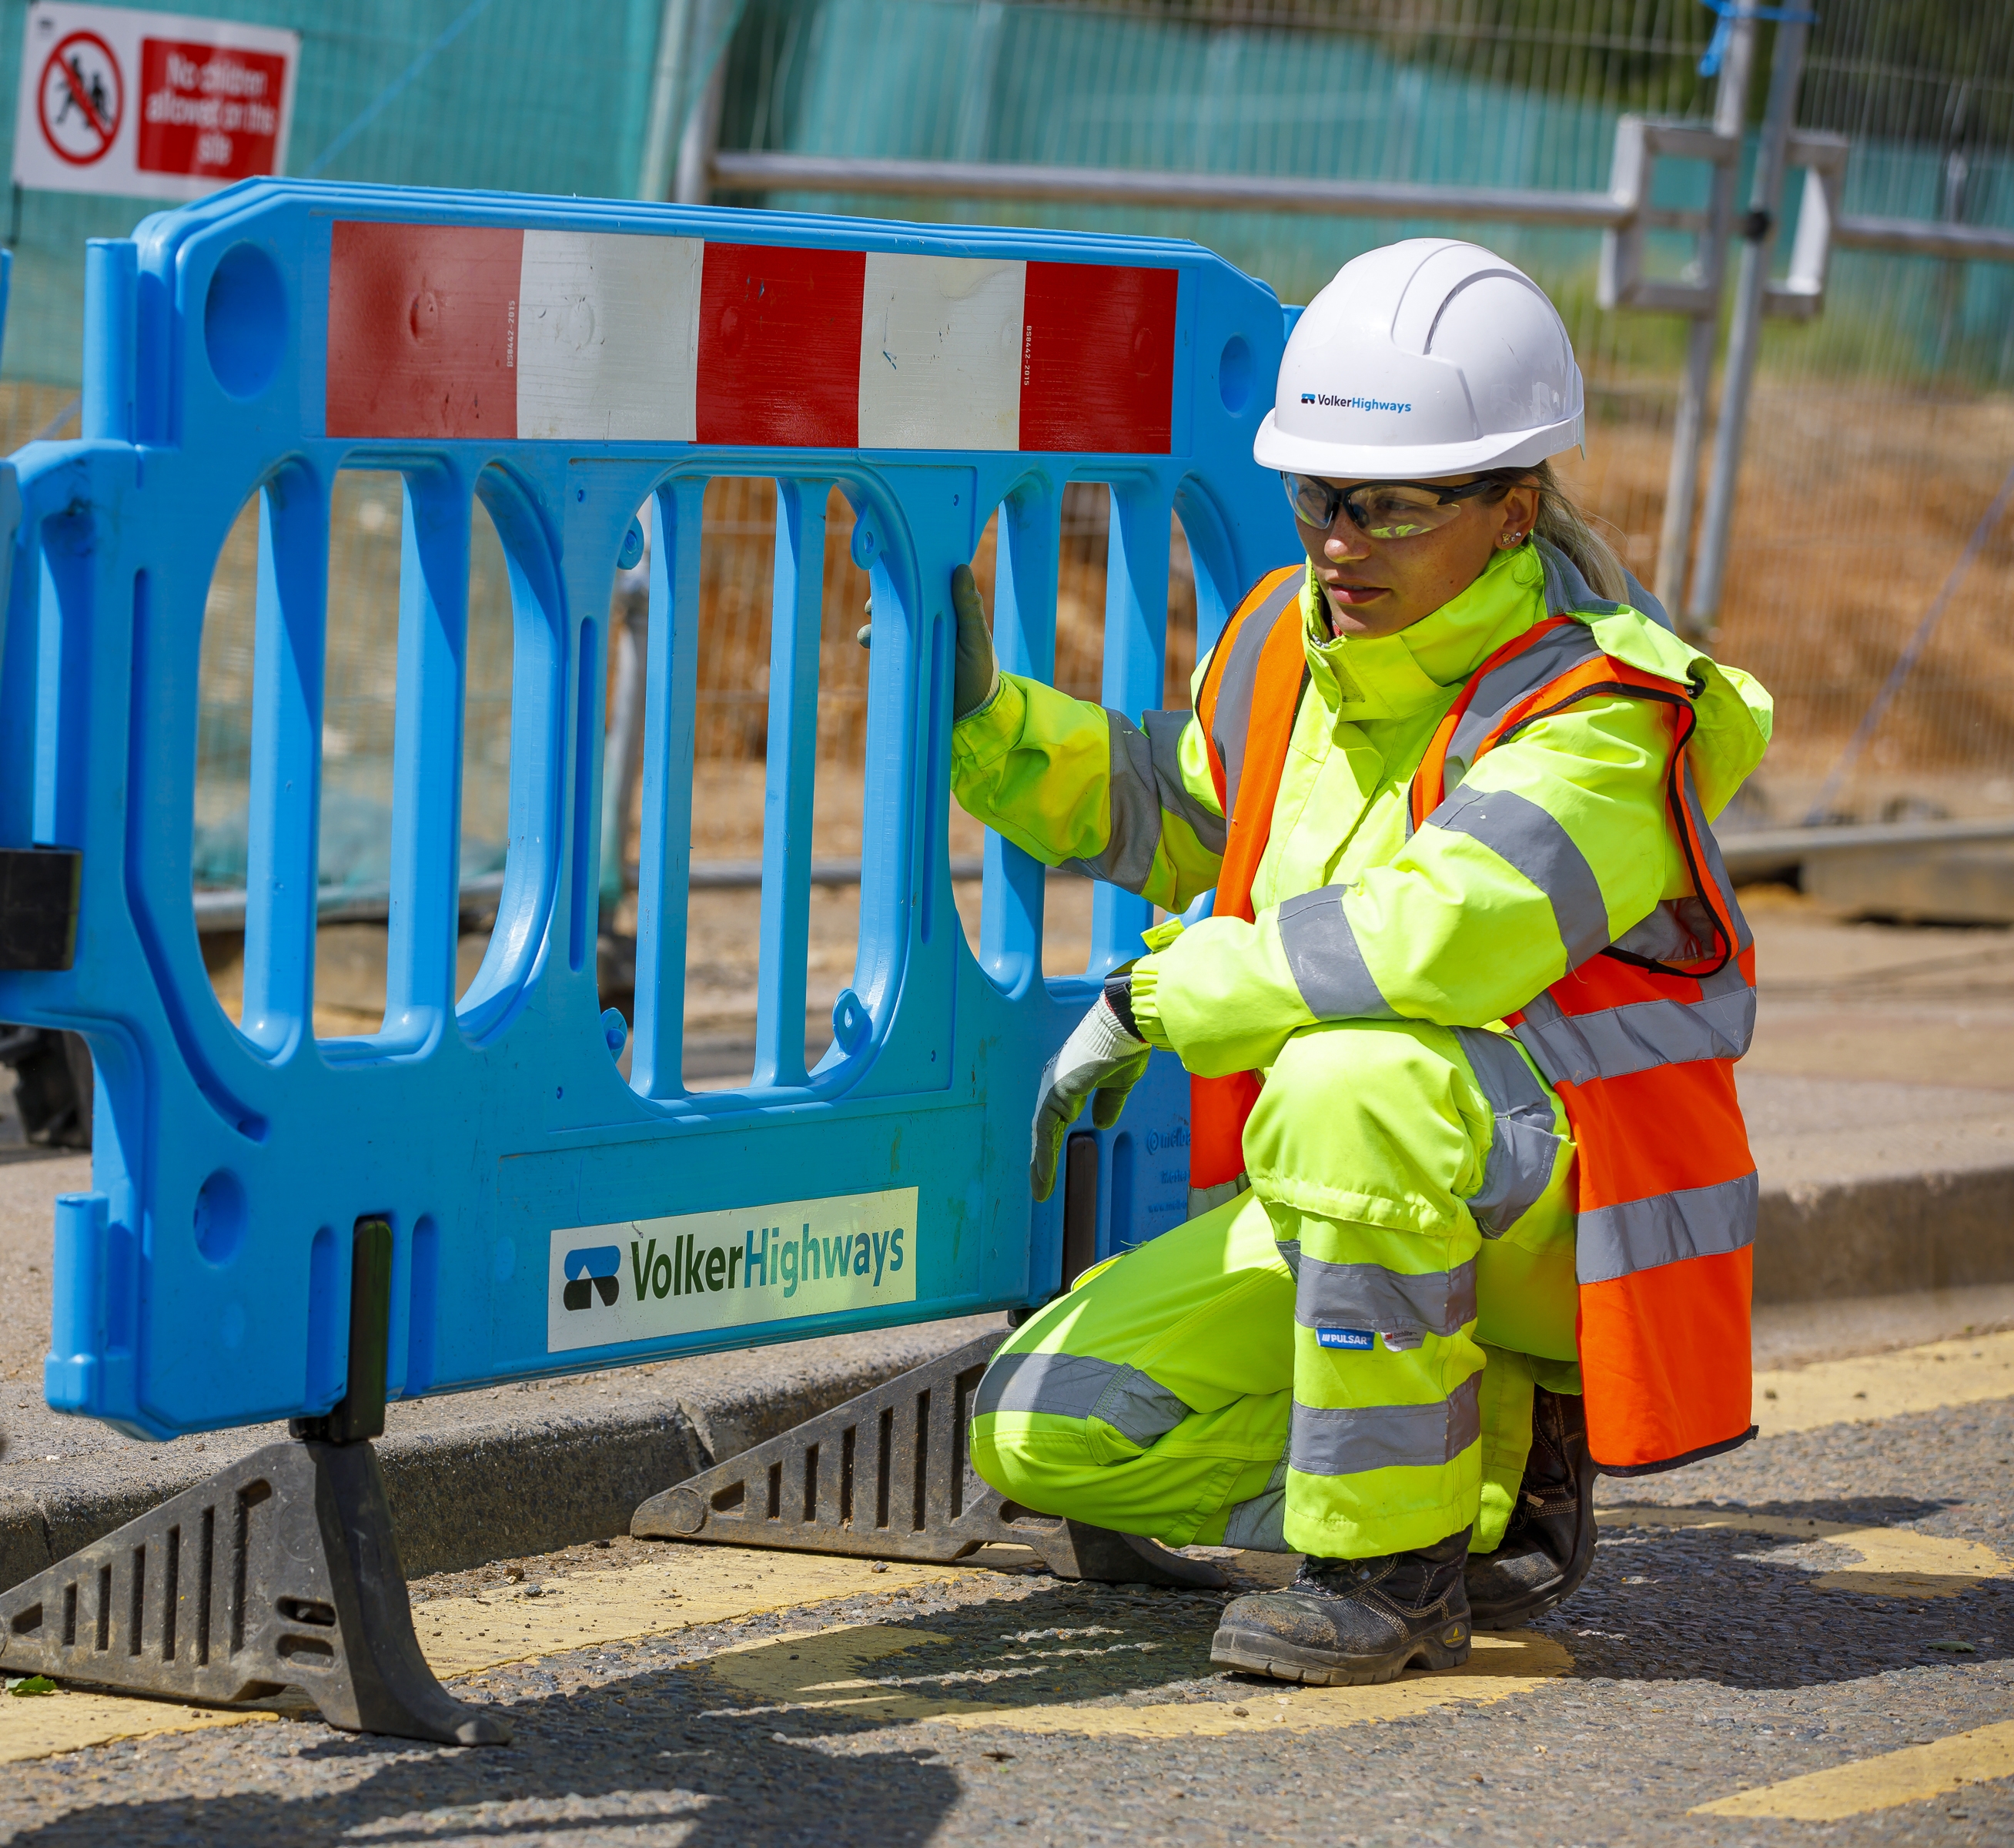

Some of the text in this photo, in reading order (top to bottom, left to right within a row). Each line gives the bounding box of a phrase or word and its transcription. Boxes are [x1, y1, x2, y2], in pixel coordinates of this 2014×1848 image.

[507, 300, 515, 367] BS8442-2015
[1024, 326, 1032, 386] BS8442-2015
[1317, 393, 1412, 413] VolkerHighways
[630, 1223, 905, 1302] VolkerHighways
